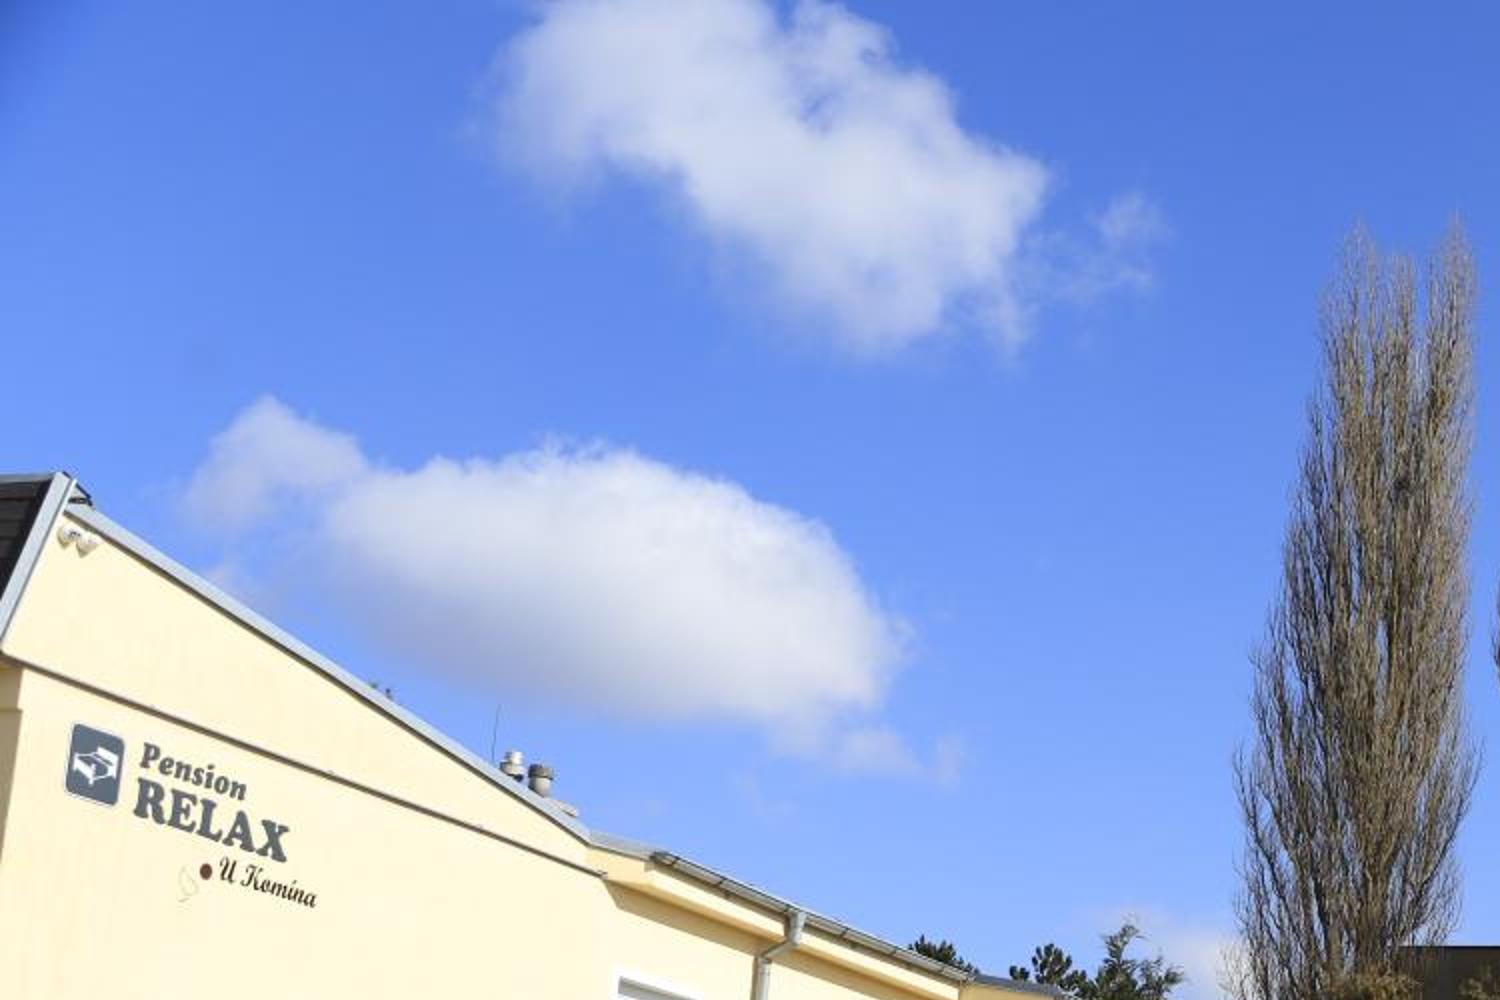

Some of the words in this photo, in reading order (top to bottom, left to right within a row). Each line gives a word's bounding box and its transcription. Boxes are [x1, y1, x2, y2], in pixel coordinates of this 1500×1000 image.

[140, 742, 247, 801] Pension
[133, 777, 290, 863] RELAX
[219, 856, 238, 884] U
